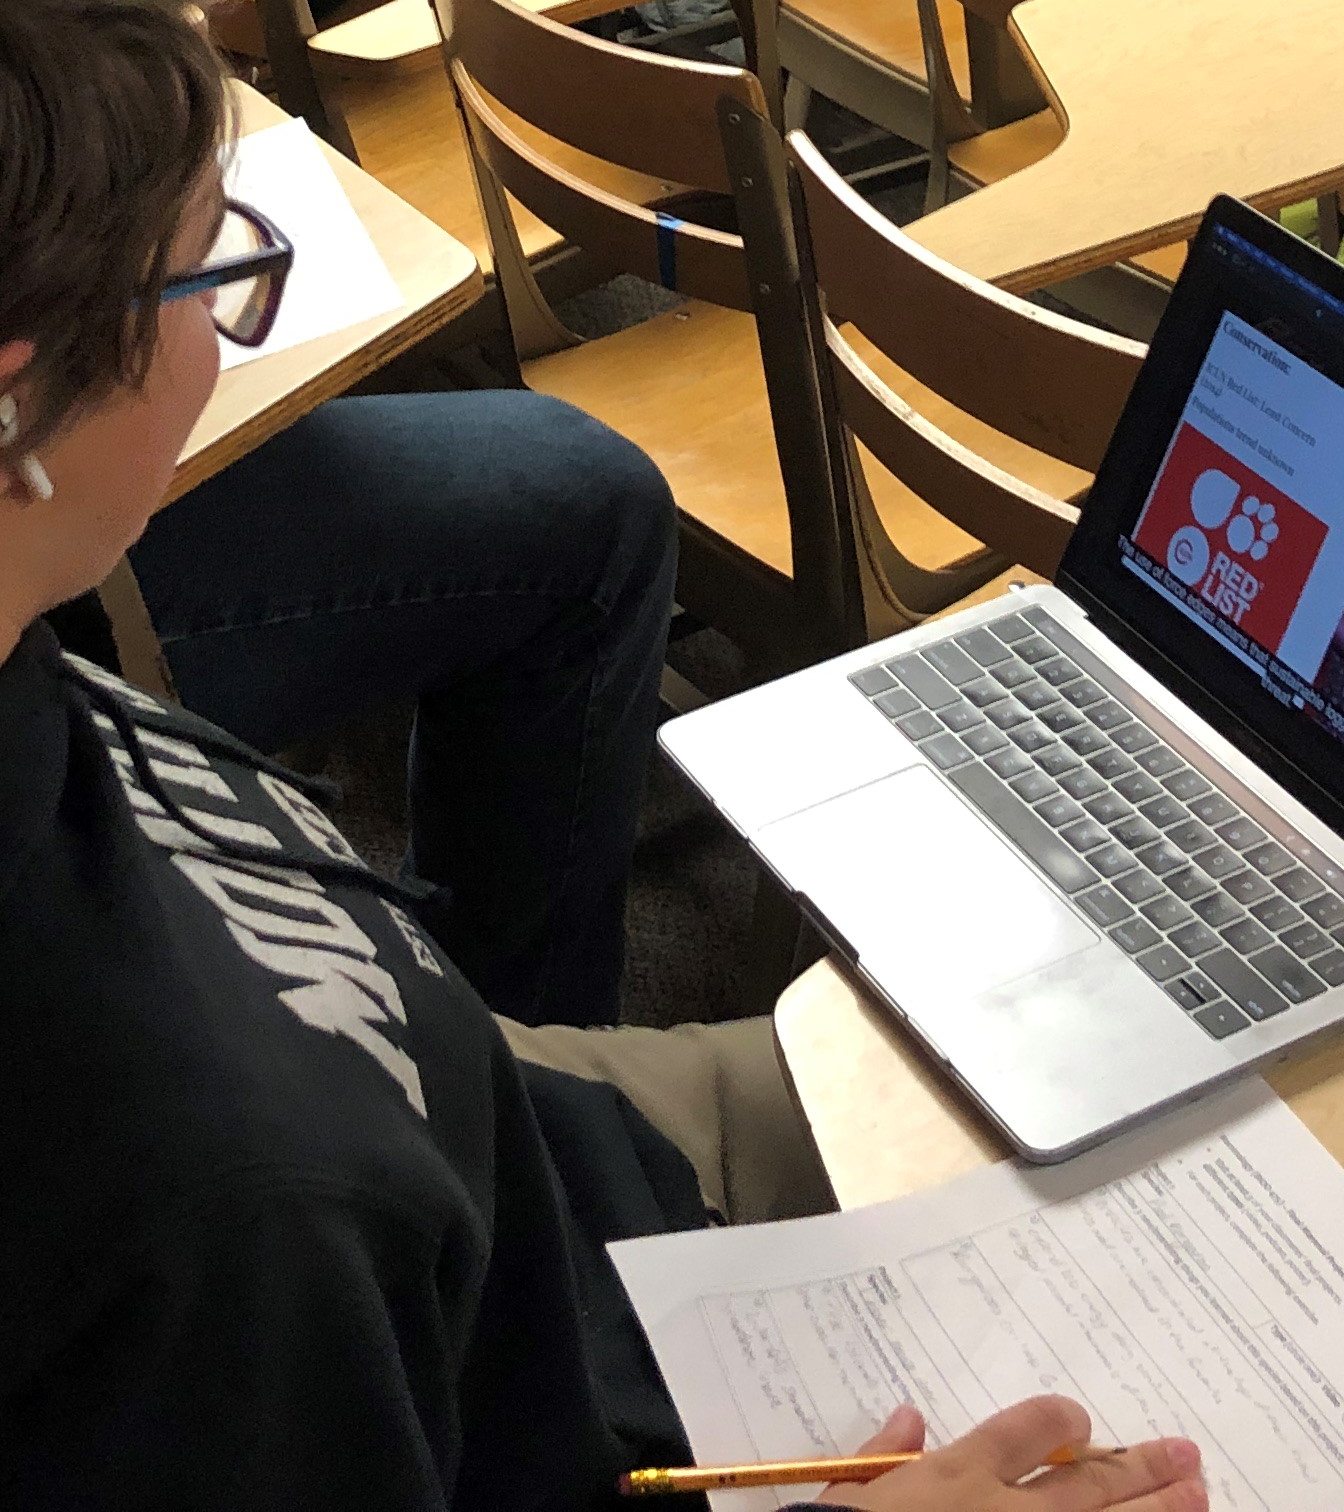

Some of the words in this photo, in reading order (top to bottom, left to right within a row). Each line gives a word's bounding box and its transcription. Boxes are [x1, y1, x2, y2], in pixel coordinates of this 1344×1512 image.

[1280, 415, 1317, 448] Concern
[1200, 572, 1251, 628] LIST
[1209, 549, 1261, 605] RED
[1215, 616, 1249, 650] means
[1247, 641, 1270, 666] that
[1268, 657, 1326, 712] sustainable
